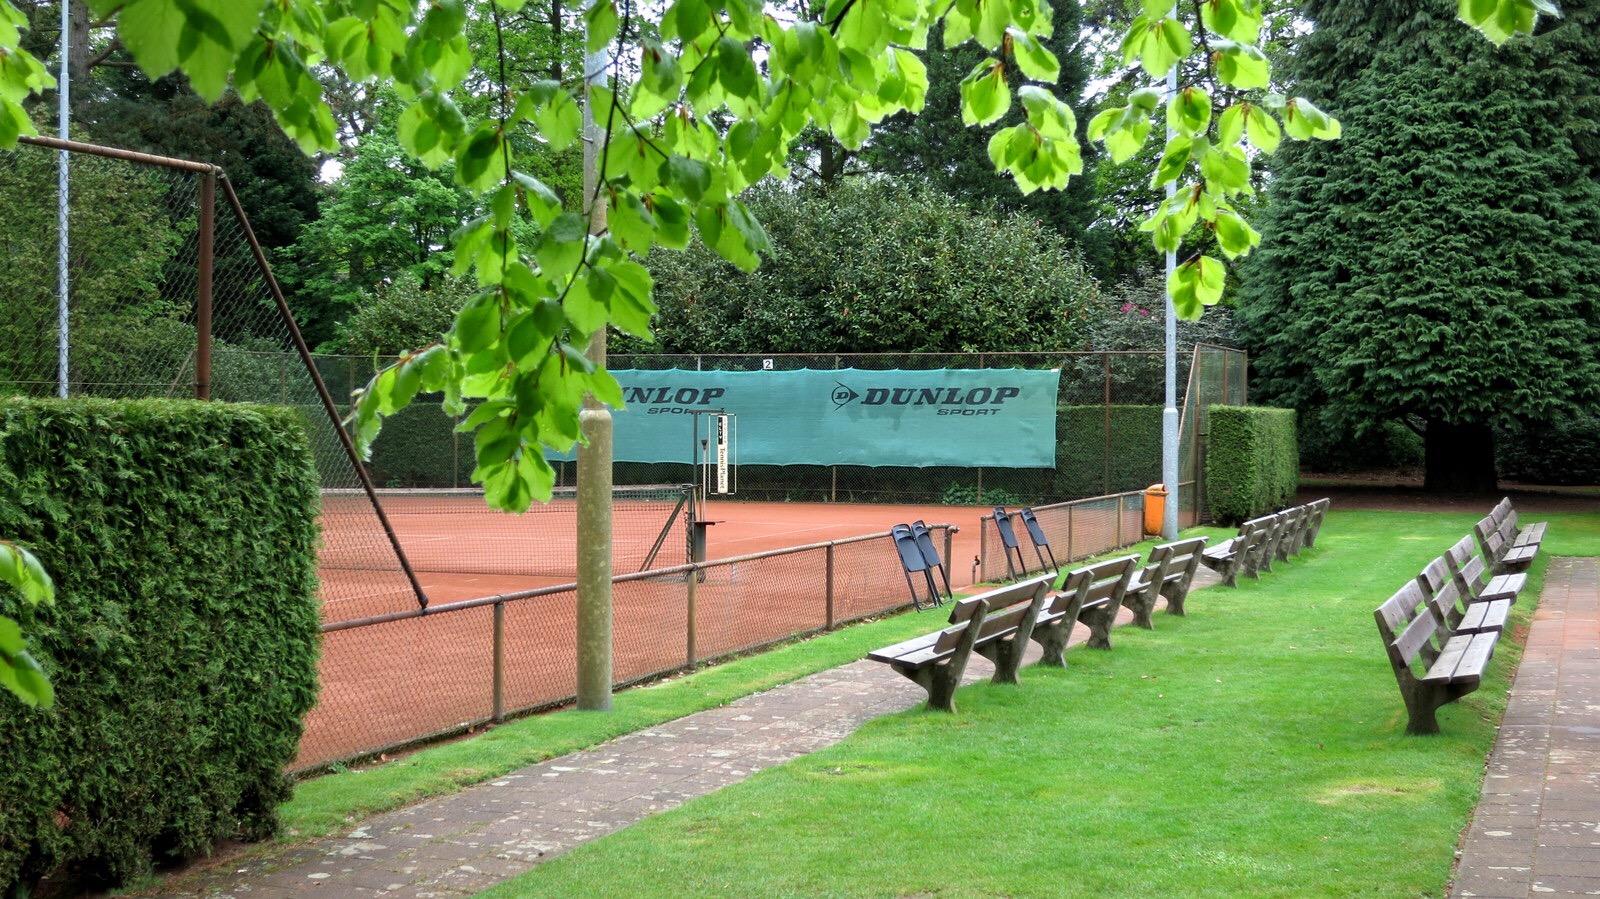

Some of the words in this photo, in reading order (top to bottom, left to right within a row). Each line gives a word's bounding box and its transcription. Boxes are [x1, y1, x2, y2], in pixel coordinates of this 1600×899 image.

[765, 360, 771, 369] 2
[621, 387, 725, 405] NLOP
[861, 387, 1020, 406] DUNLOP
[937, 408, 1001, 416] SPORT
